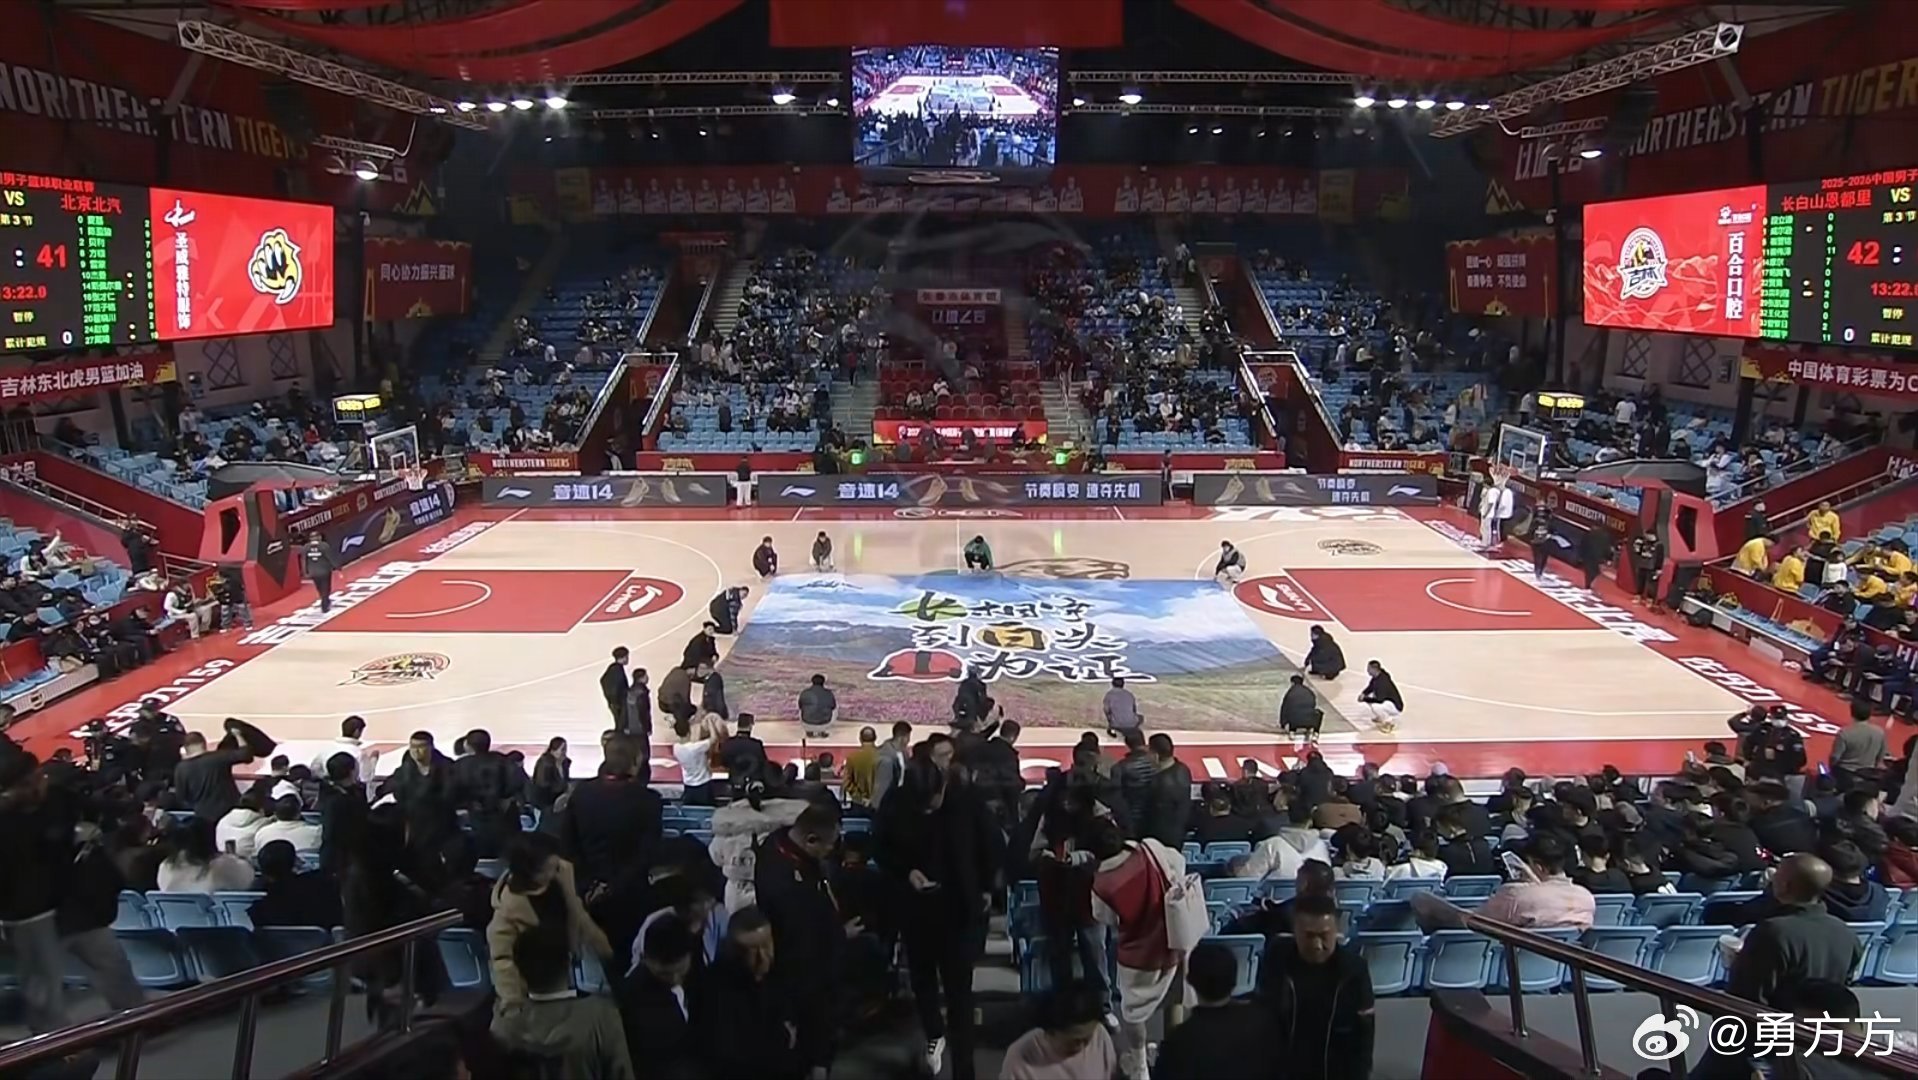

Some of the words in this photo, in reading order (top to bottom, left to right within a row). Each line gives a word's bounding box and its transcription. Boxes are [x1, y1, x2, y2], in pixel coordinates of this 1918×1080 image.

[0, 172, 94, 192] 男子篮球职业联赛
[4, 190, 25, 206] VS
[61, 194, 122, 213] 北京北汽
[1781, 189, 1872, 211] 长白山恩都里
[1890, 187, 1911, 203] VS
[36, 244, 67, 269] 41
[1847, 241, 1880, 265] 42
[1725, 231, 1746, 319] 百合口腔
[62, 331, 73, 344] 0
[1844, 328, 1855, 341] 0
[0, 361, 144, 398] 吉林东北虎男篮加油
[1788, 358, 1918, 392] 中国体育彩票为C
[837, 483, 900, 499] 音速14
[888, 591, 1095, 622] 长相守
